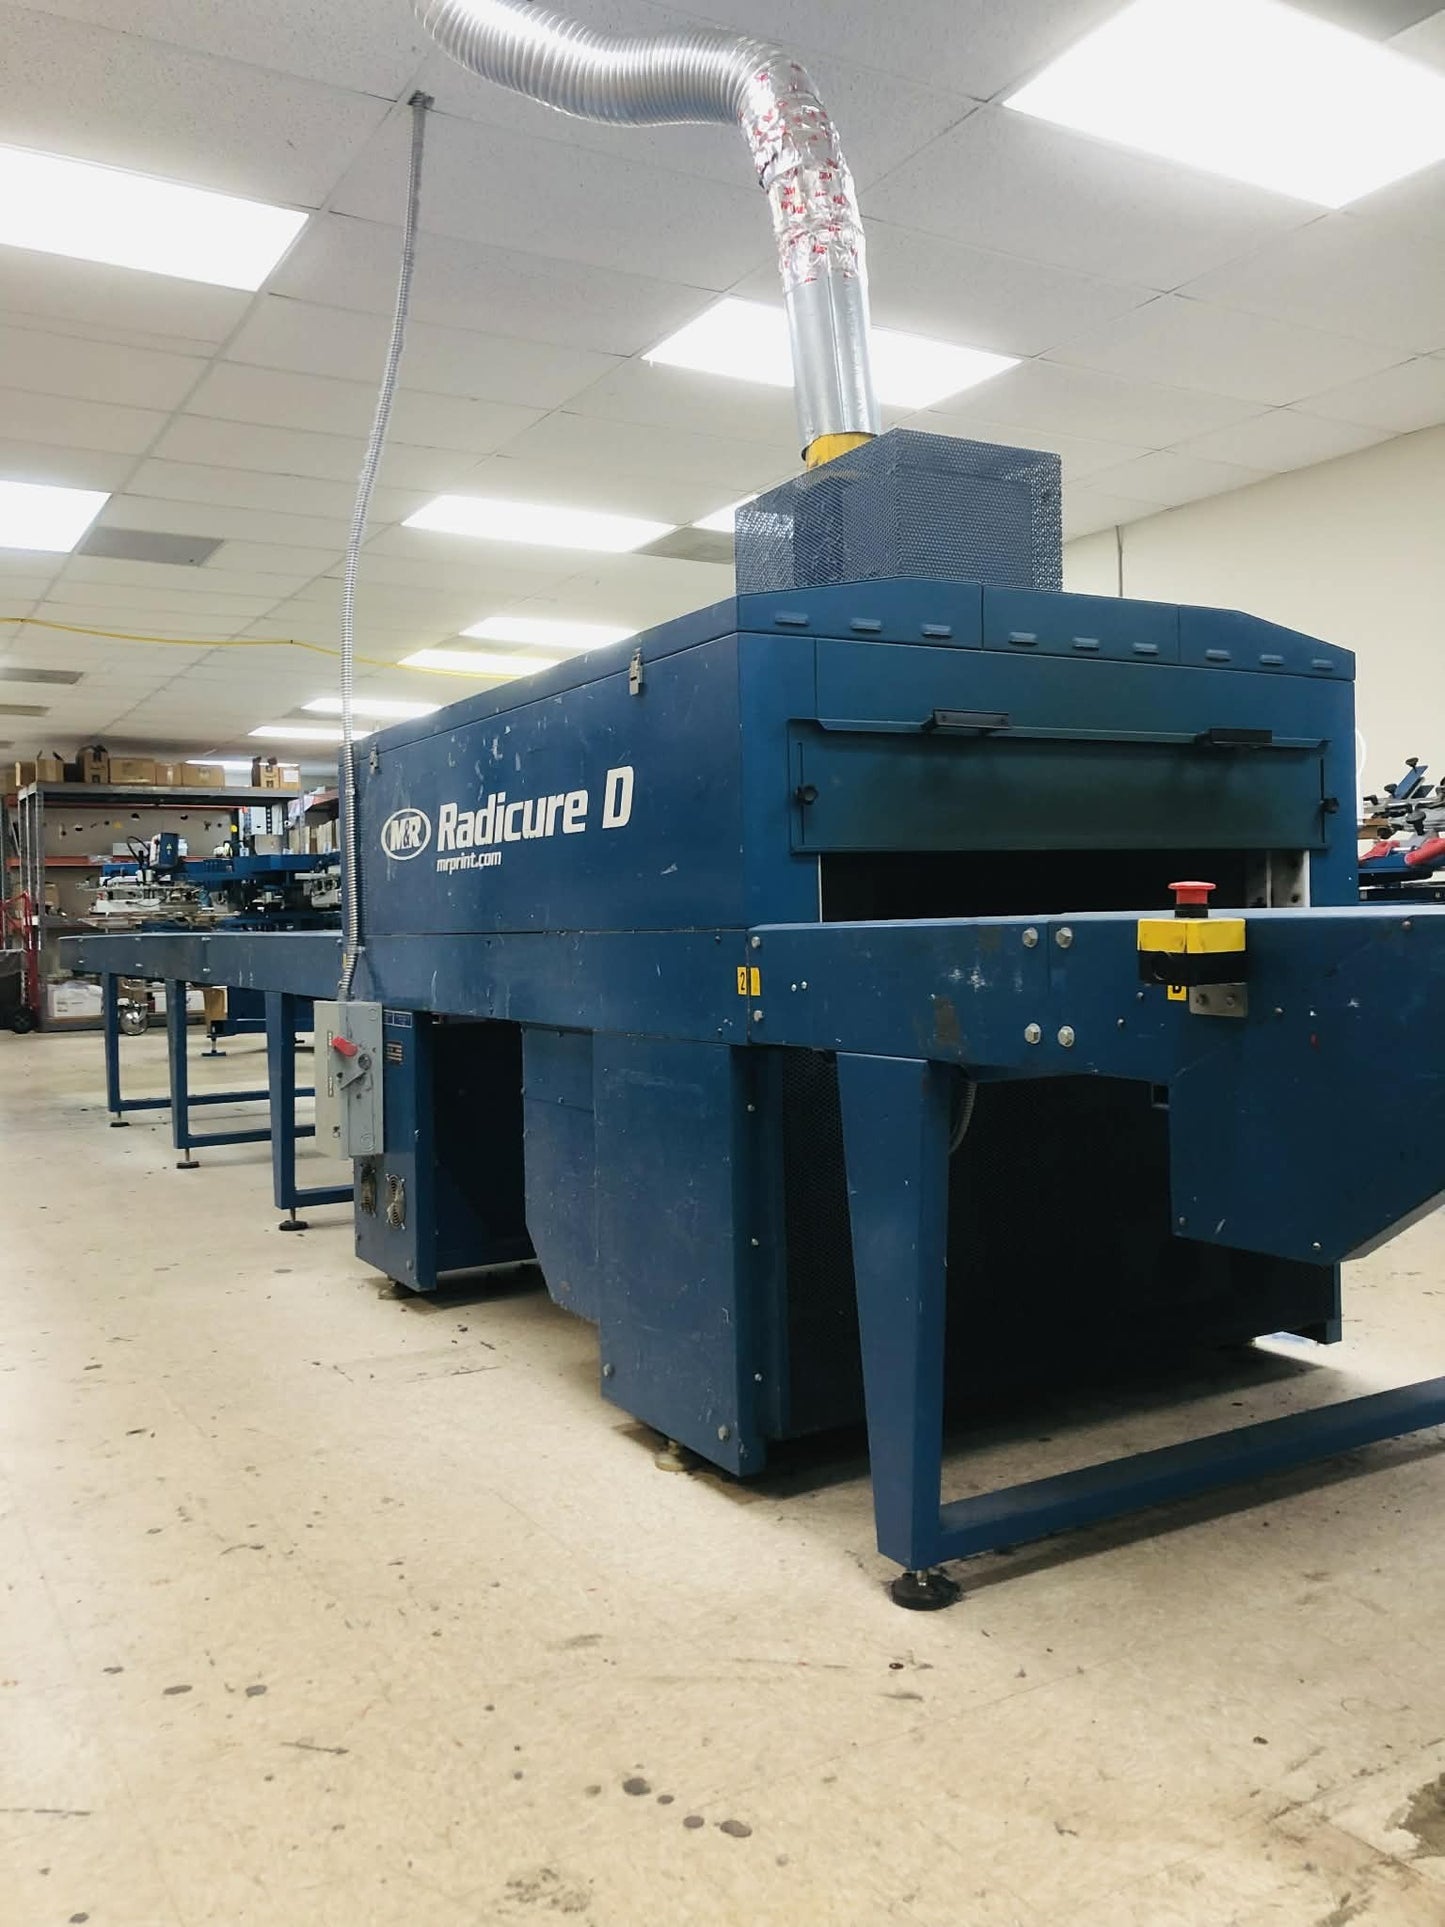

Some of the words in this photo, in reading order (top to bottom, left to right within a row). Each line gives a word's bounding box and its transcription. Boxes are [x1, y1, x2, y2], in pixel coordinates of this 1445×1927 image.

[437, 789, 589, 852] Radicure
[602, 765, 635, 829] D
[436, 851, 502, 875] mrprint.com
[740, 972, 745, 990] 2
